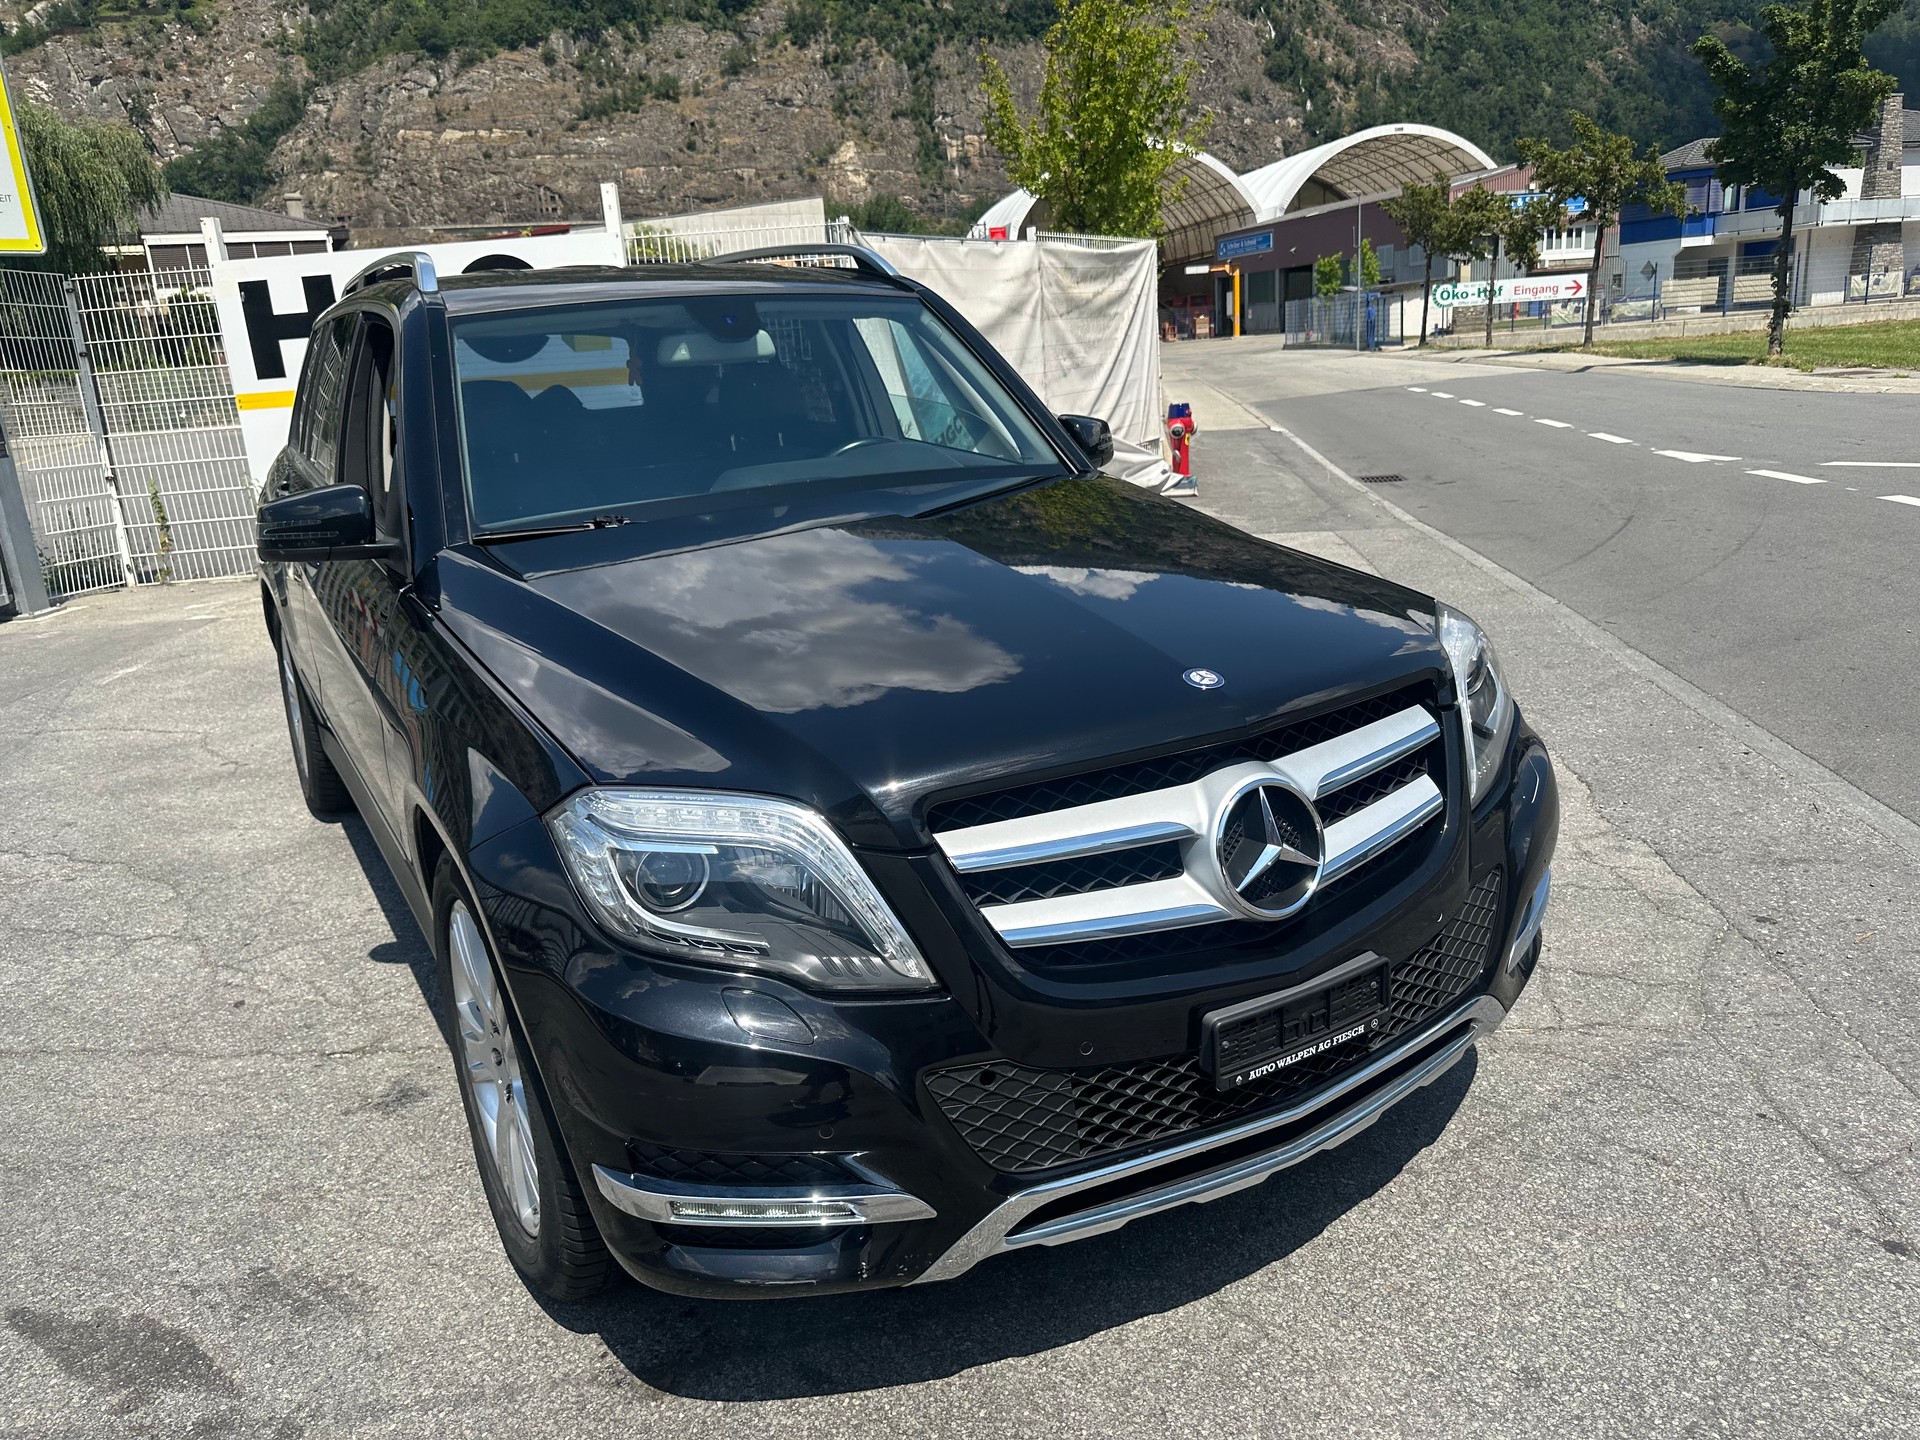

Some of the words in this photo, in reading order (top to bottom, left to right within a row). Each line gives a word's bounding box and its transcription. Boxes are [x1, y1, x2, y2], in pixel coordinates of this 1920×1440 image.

[1514, 285, 1559, 296] Eingang
[1248, 1063, 1276, 1080] AUTO
[1276, 1046, 1317, 1068] WALPEN
[1318, 1040, 1331, 1052] AG
[1333, 1025, 1365, 1046] FIESCH
